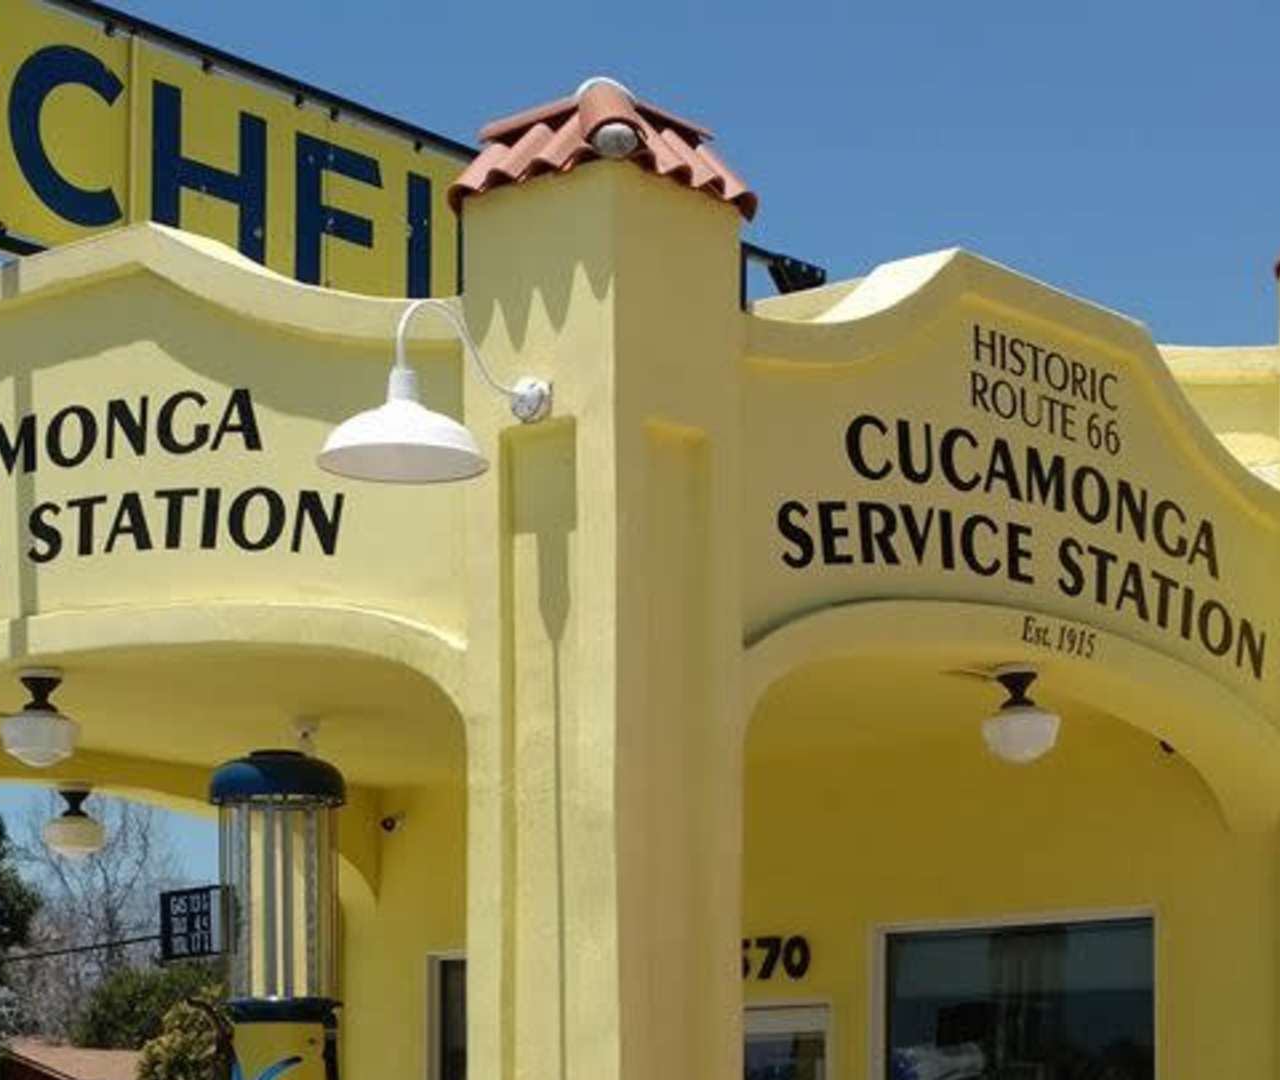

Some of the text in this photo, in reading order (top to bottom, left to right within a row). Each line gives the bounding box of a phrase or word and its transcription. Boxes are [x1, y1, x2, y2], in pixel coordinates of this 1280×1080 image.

[972, 324, 1119, 410] HISTORIC
[971, 371, 1121, 456] ROUTE 66
[26, 487, 346, 564] STATION
[845, 414, 1220, 579] CUCAMONGA
[776, 501, 1267, 681] SERVICE STATION
[1022, 615, 1097, 659] Est. 1915
